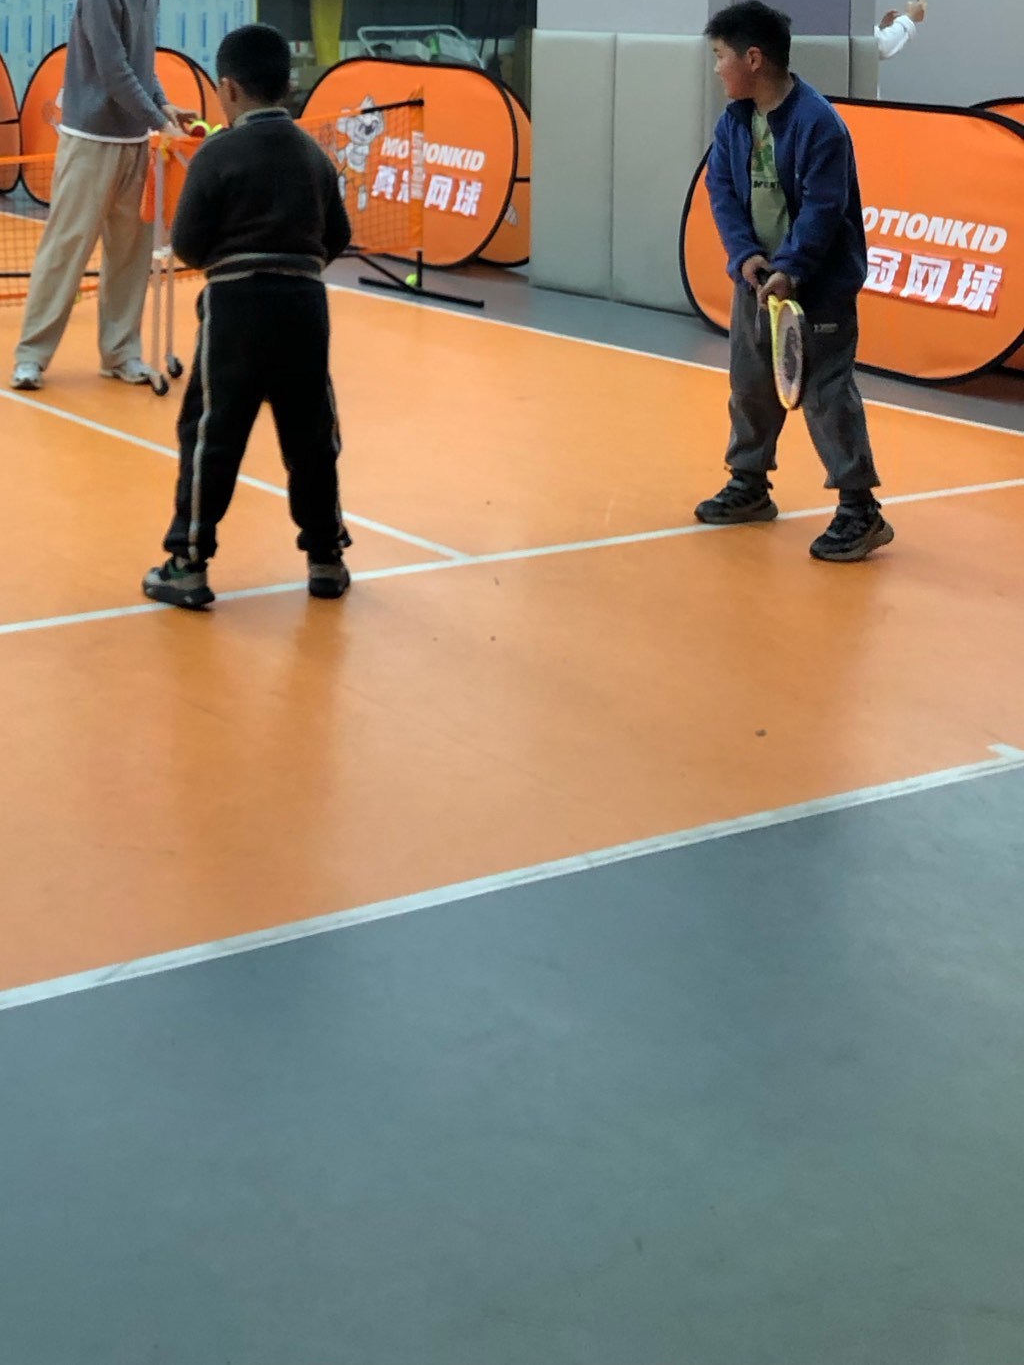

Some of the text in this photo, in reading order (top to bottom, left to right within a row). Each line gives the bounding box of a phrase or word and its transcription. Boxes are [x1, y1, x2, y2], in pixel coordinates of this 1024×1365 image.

[380, 136, 486, 172] MOONKID
[862, 206, 1008, 254] OTIONKID
[863, 245, 1003, 312] 冠网球
